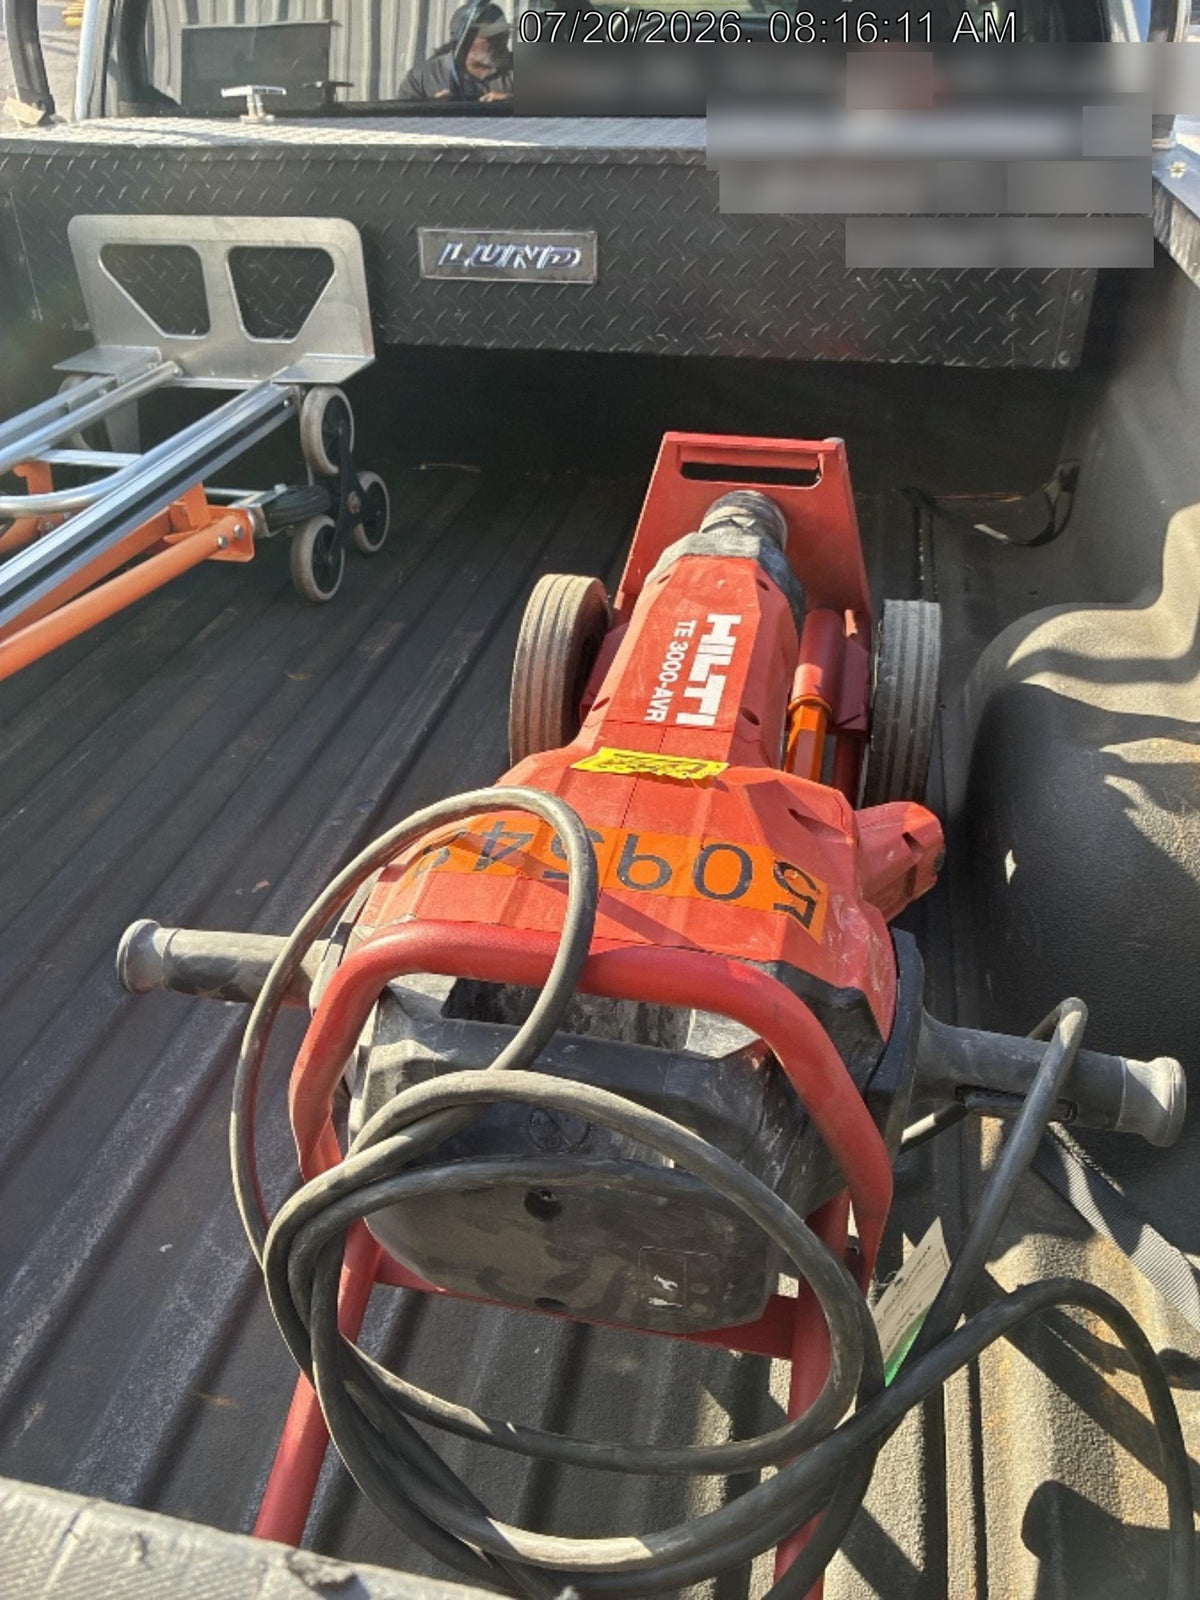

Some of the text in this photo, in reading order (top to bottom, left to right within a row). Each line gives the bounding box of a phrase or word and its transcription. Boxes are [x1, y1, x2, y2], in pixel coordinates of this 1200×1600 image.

[437, 241, 582, 270] LUND
[644, 619, 698, 723] TE 3000-AVR
[675, 613, 742, 727] HILTI
